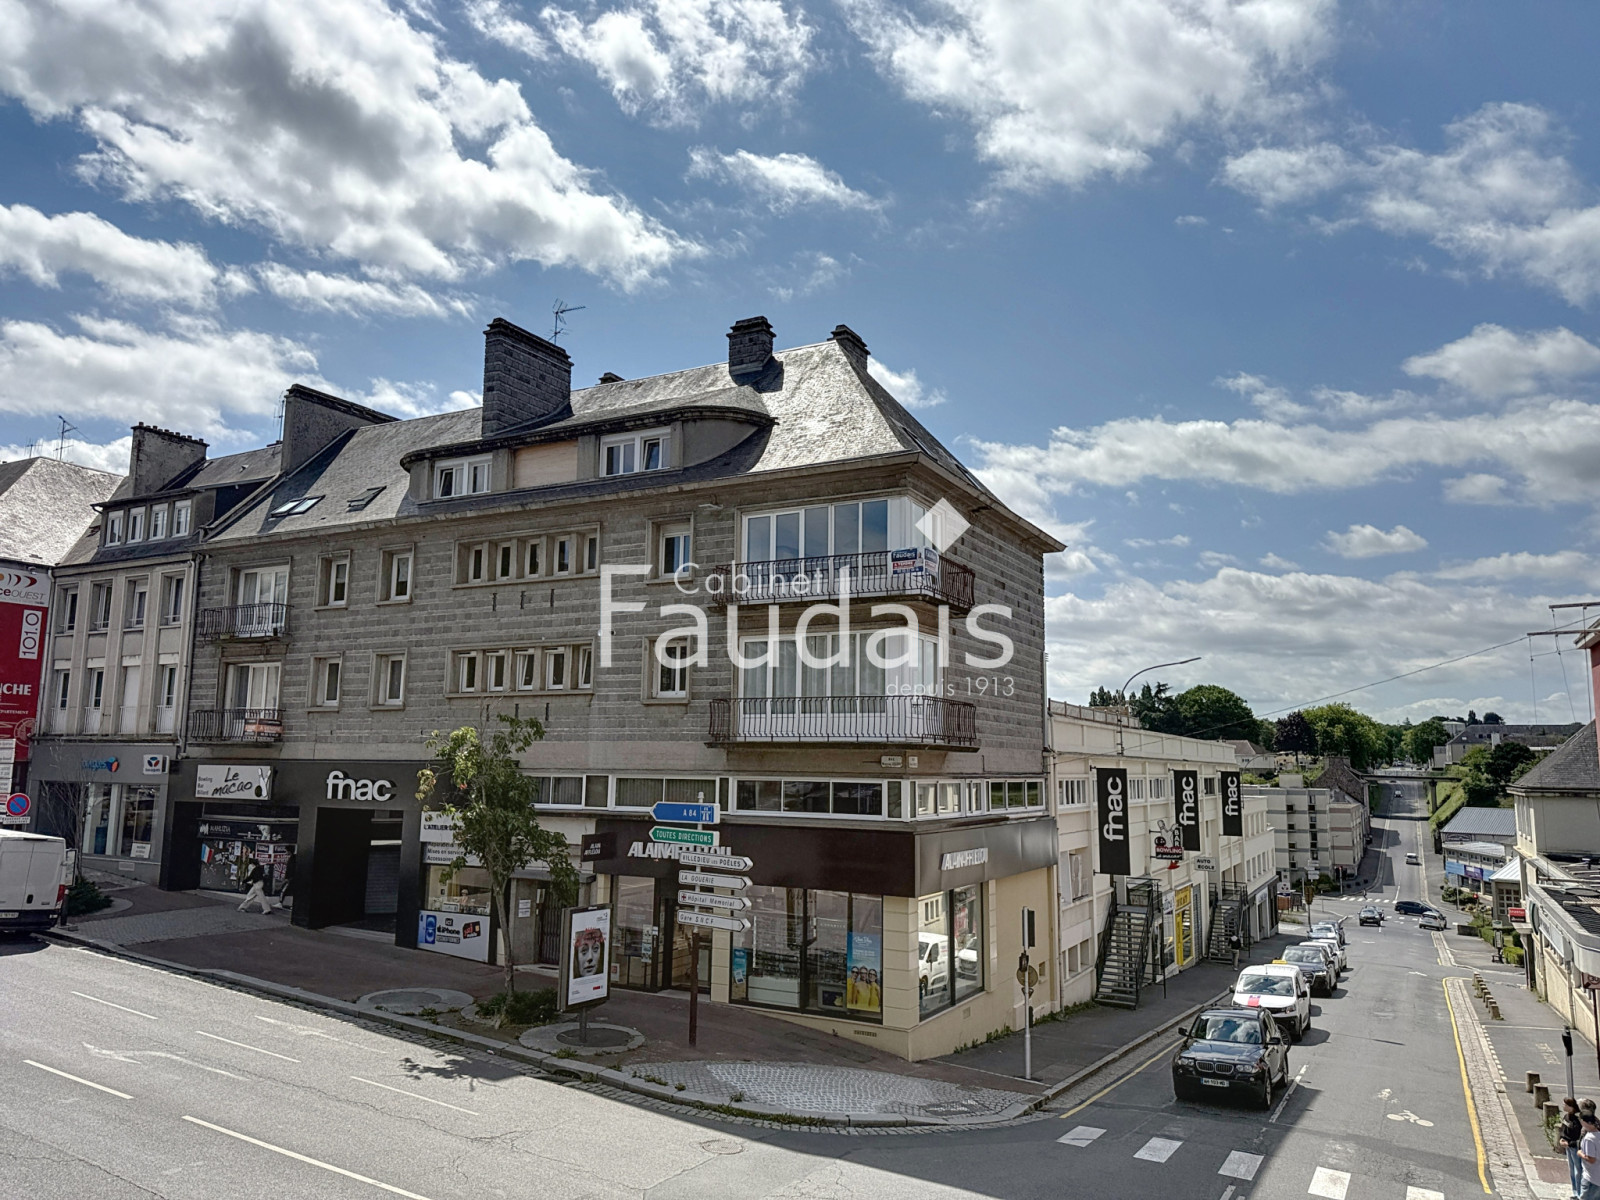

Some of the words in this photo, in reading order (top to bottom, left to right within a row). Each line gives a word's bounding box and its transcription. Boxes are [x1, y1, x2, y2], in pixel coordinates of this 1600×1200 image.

[22, 612, 39, 655] 101.0
[224, 767, 240, 782] Le
[212, 781, 253, 796] macao
[326, 770, 393, 801] fnac
[1179, 776, 1195, 825] fnac
[1225, 776, 1238, 817] fnac
[1103, 776, 1124, 842] fnac
[656, 830, 676, 839] TOUTES
[678, 831, 712, 843] DIRECTIONS
[682, 854, 710, 864] VILLEDIEU
[719, 857, 741, 867] POÊLES
[691, 876, 714, 884] GOUERIE
[688, 895, 707, 903] Hôpital
[680, 914, 692, 922] Gare
